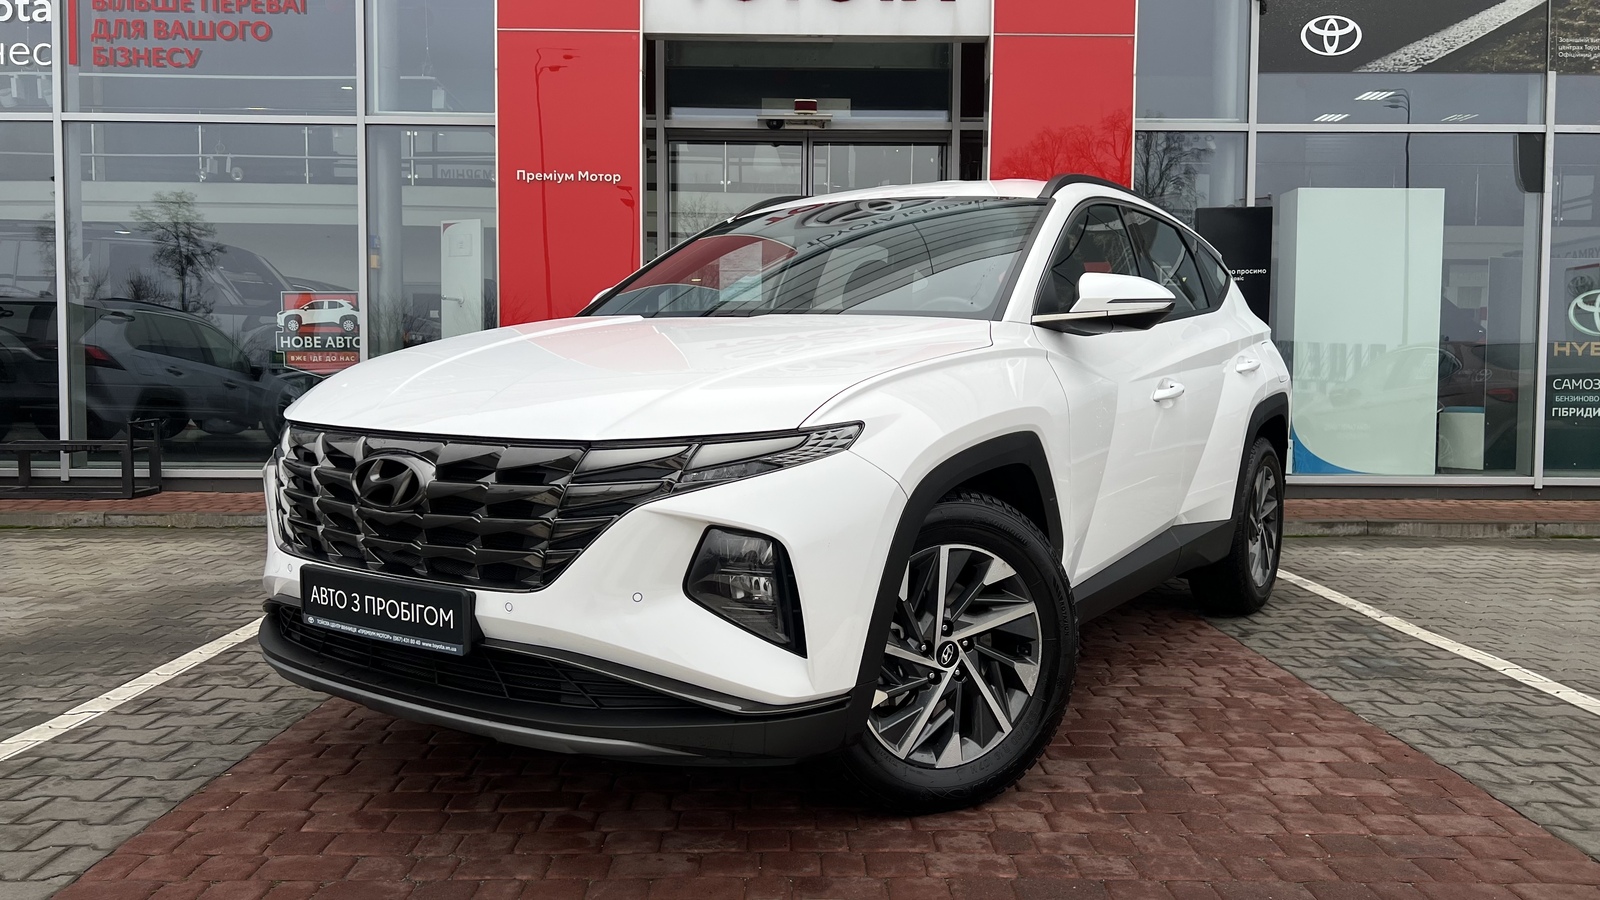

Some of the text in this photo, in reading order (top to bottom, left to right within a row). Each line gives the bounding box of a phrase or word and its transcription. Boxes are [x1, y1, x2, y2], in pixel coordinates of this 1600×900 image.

[91, 19, 273, 43] ДЛЯ ВАШОГО
[0, 42, 51, 66] ес
[92, 47, 203, 68] БІЗНЕСУ
[516, 169, 621, 184] Преміум Мотор
[1237, 268, 1267, 276] просимо
[280, 336, 322, 348] НОВЕ
[310, 585, 347, 609] АВТО
[364, 595, 454, 629] ПРОБІГОМ
